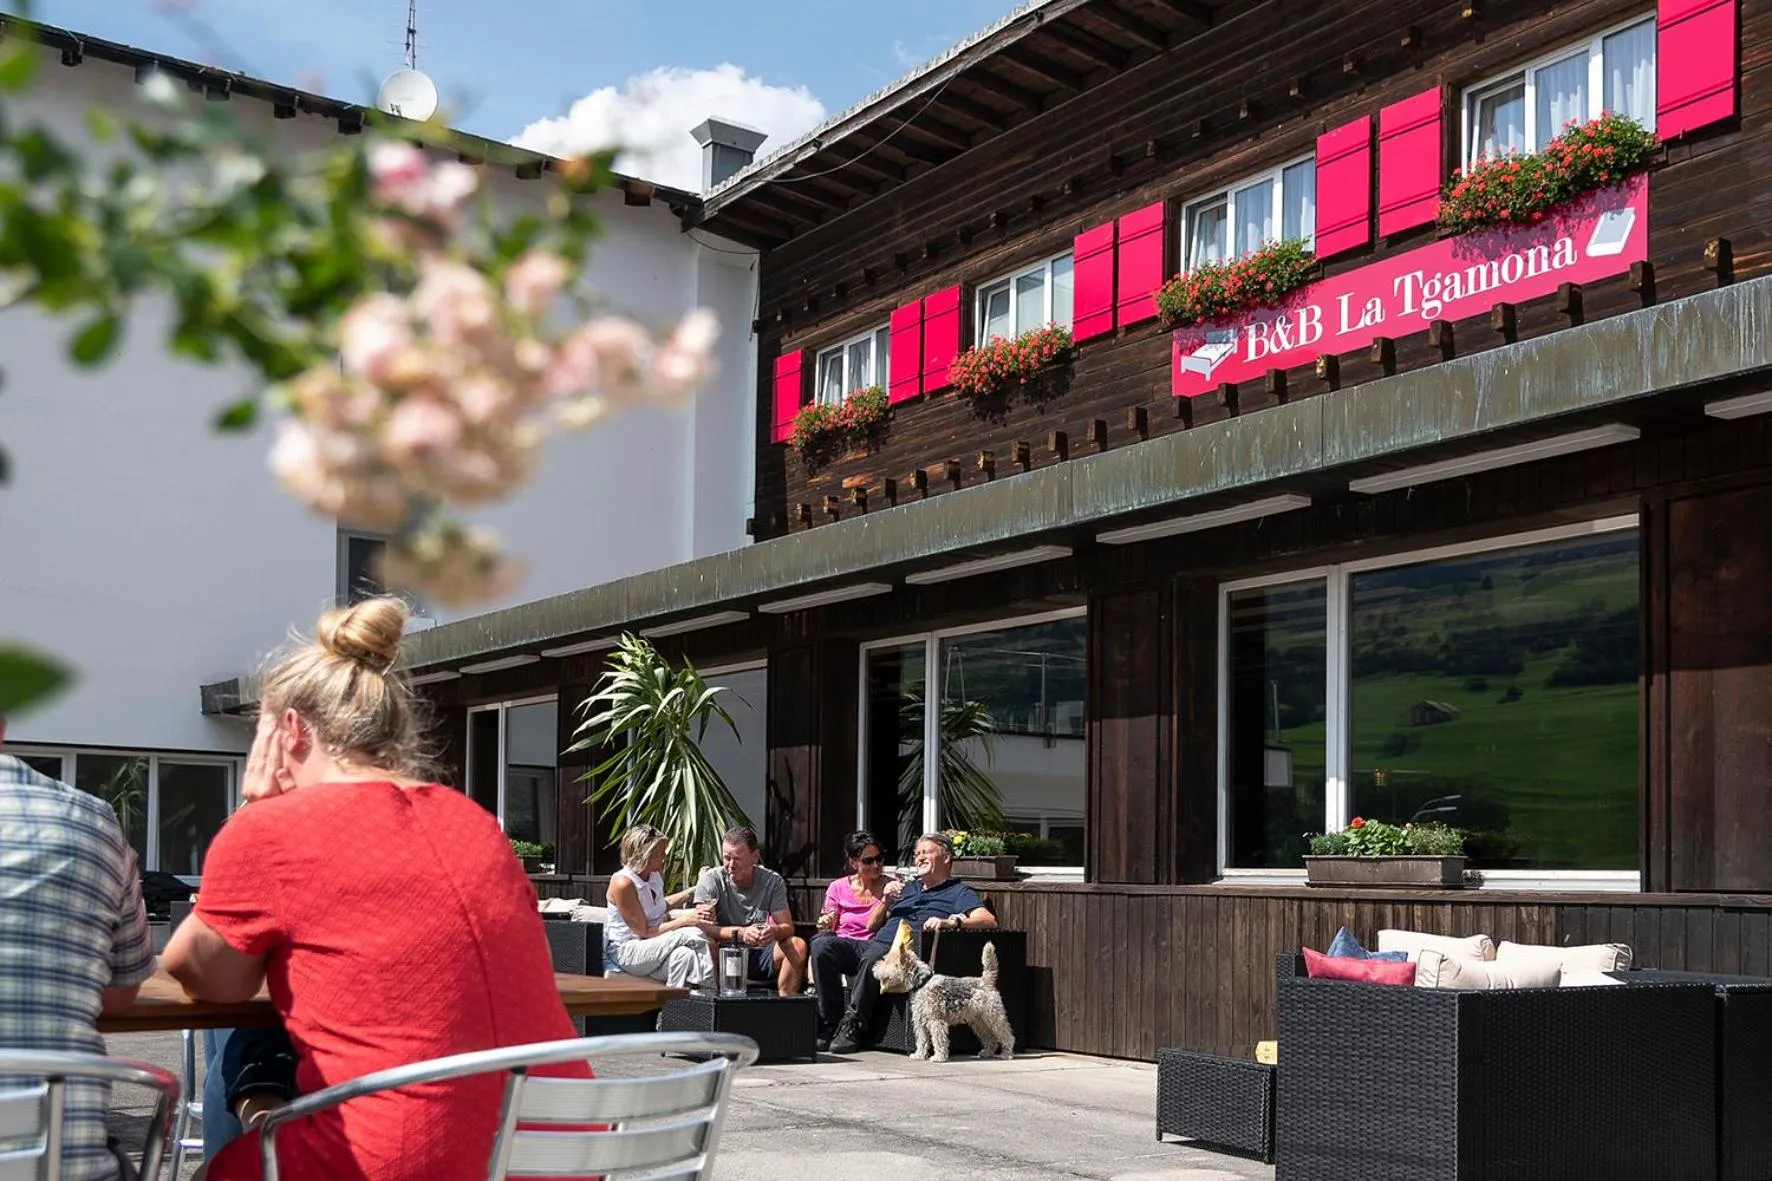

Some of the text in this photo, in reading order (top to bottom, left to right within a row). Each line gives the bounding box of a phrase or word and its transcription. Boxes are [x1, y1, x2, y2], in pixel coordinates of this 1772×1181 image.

[1244, 236, 1577, 363] B&B La Tgamona
